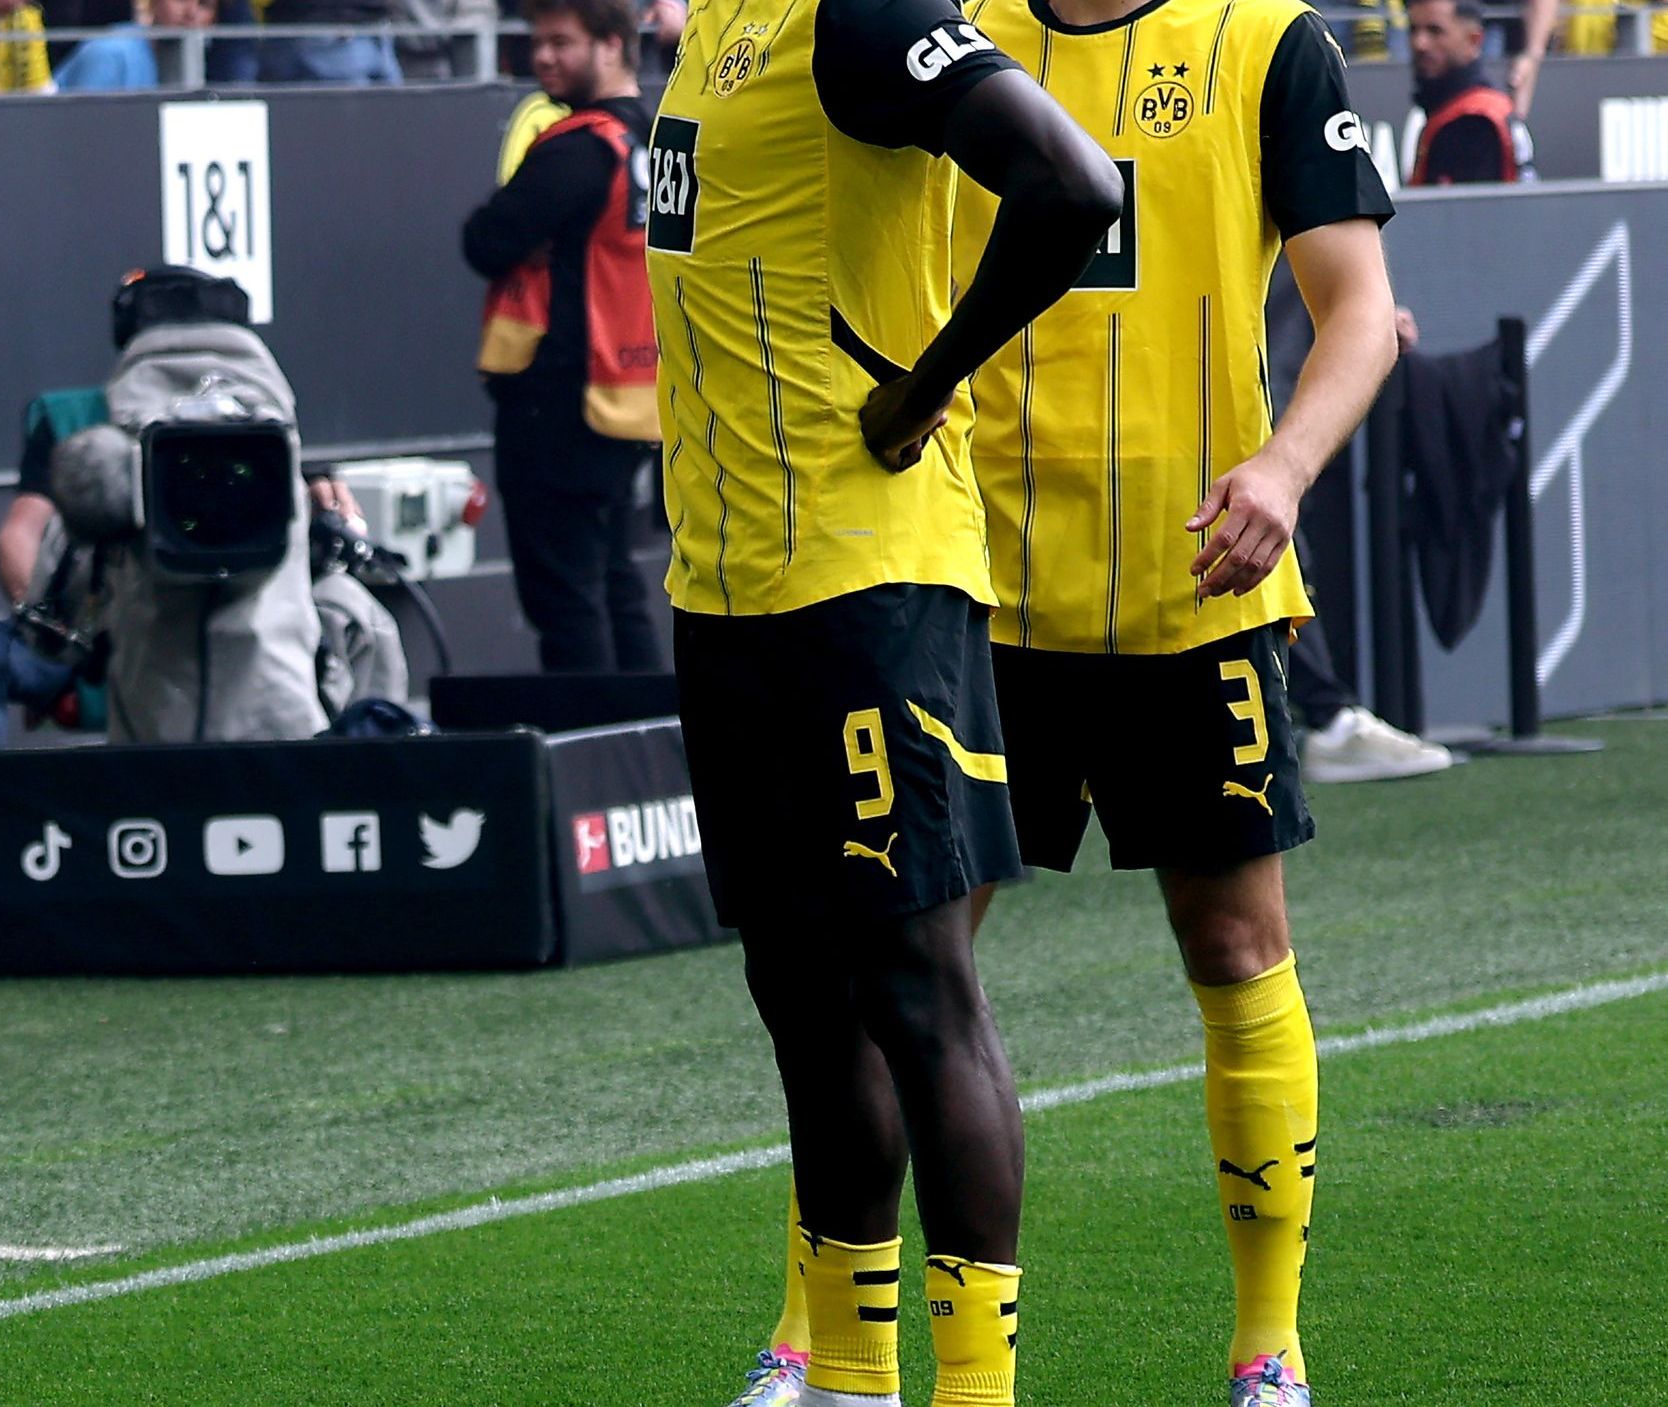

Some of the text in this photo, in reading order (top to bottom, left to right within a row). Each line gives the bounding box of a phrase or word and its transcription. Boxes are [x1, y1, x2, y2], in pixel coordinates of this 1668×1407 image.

[719, 44, 751, 80] BVB
[906, 23, 997, 82] GLS
[1141, 86, 1189, 123] BVB
[1153, 121, 1171, 134] 09
[651, 147, 691, 216] 1&1
[177, 160, 254, 264] 1&1
[1219, 659, 1269, 765] 3
[843, 707, 895, 821] 9
[607, 795, 702, 868] BUND
[1229, 1204, 1258, 1221] 09
[929, 1300, 954, 1316] 09
